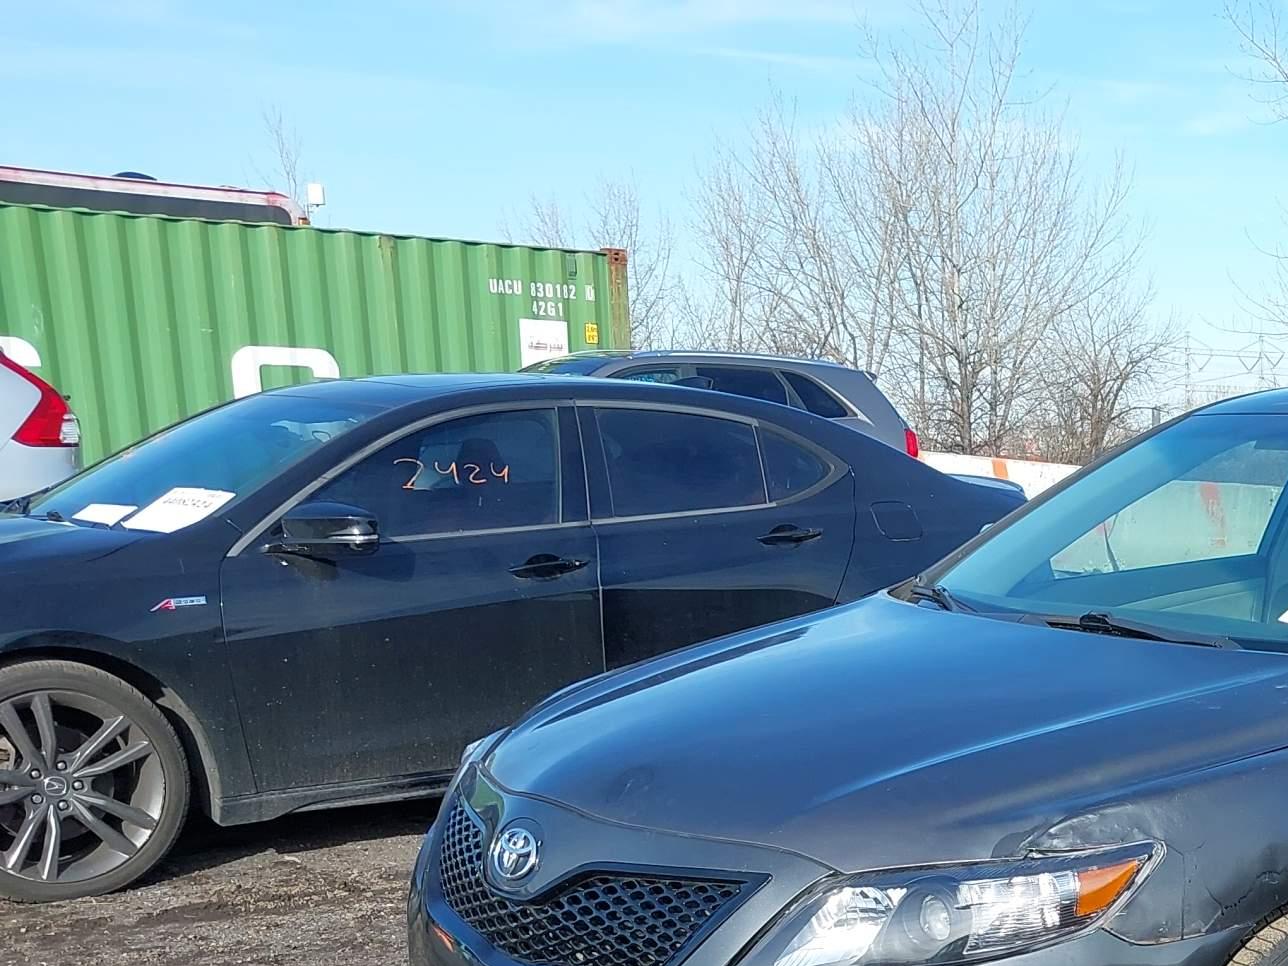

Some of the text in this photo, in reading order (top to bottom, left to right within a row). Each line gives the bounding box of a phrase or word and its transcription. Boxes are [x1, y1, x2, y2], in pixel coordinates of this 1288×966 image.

[489, 278, 522, 295] UACU
[530, 282, 577, 299] 830182
[532, 300, 563, 317] 42G1
[393, 458, 509, 490] 2424
